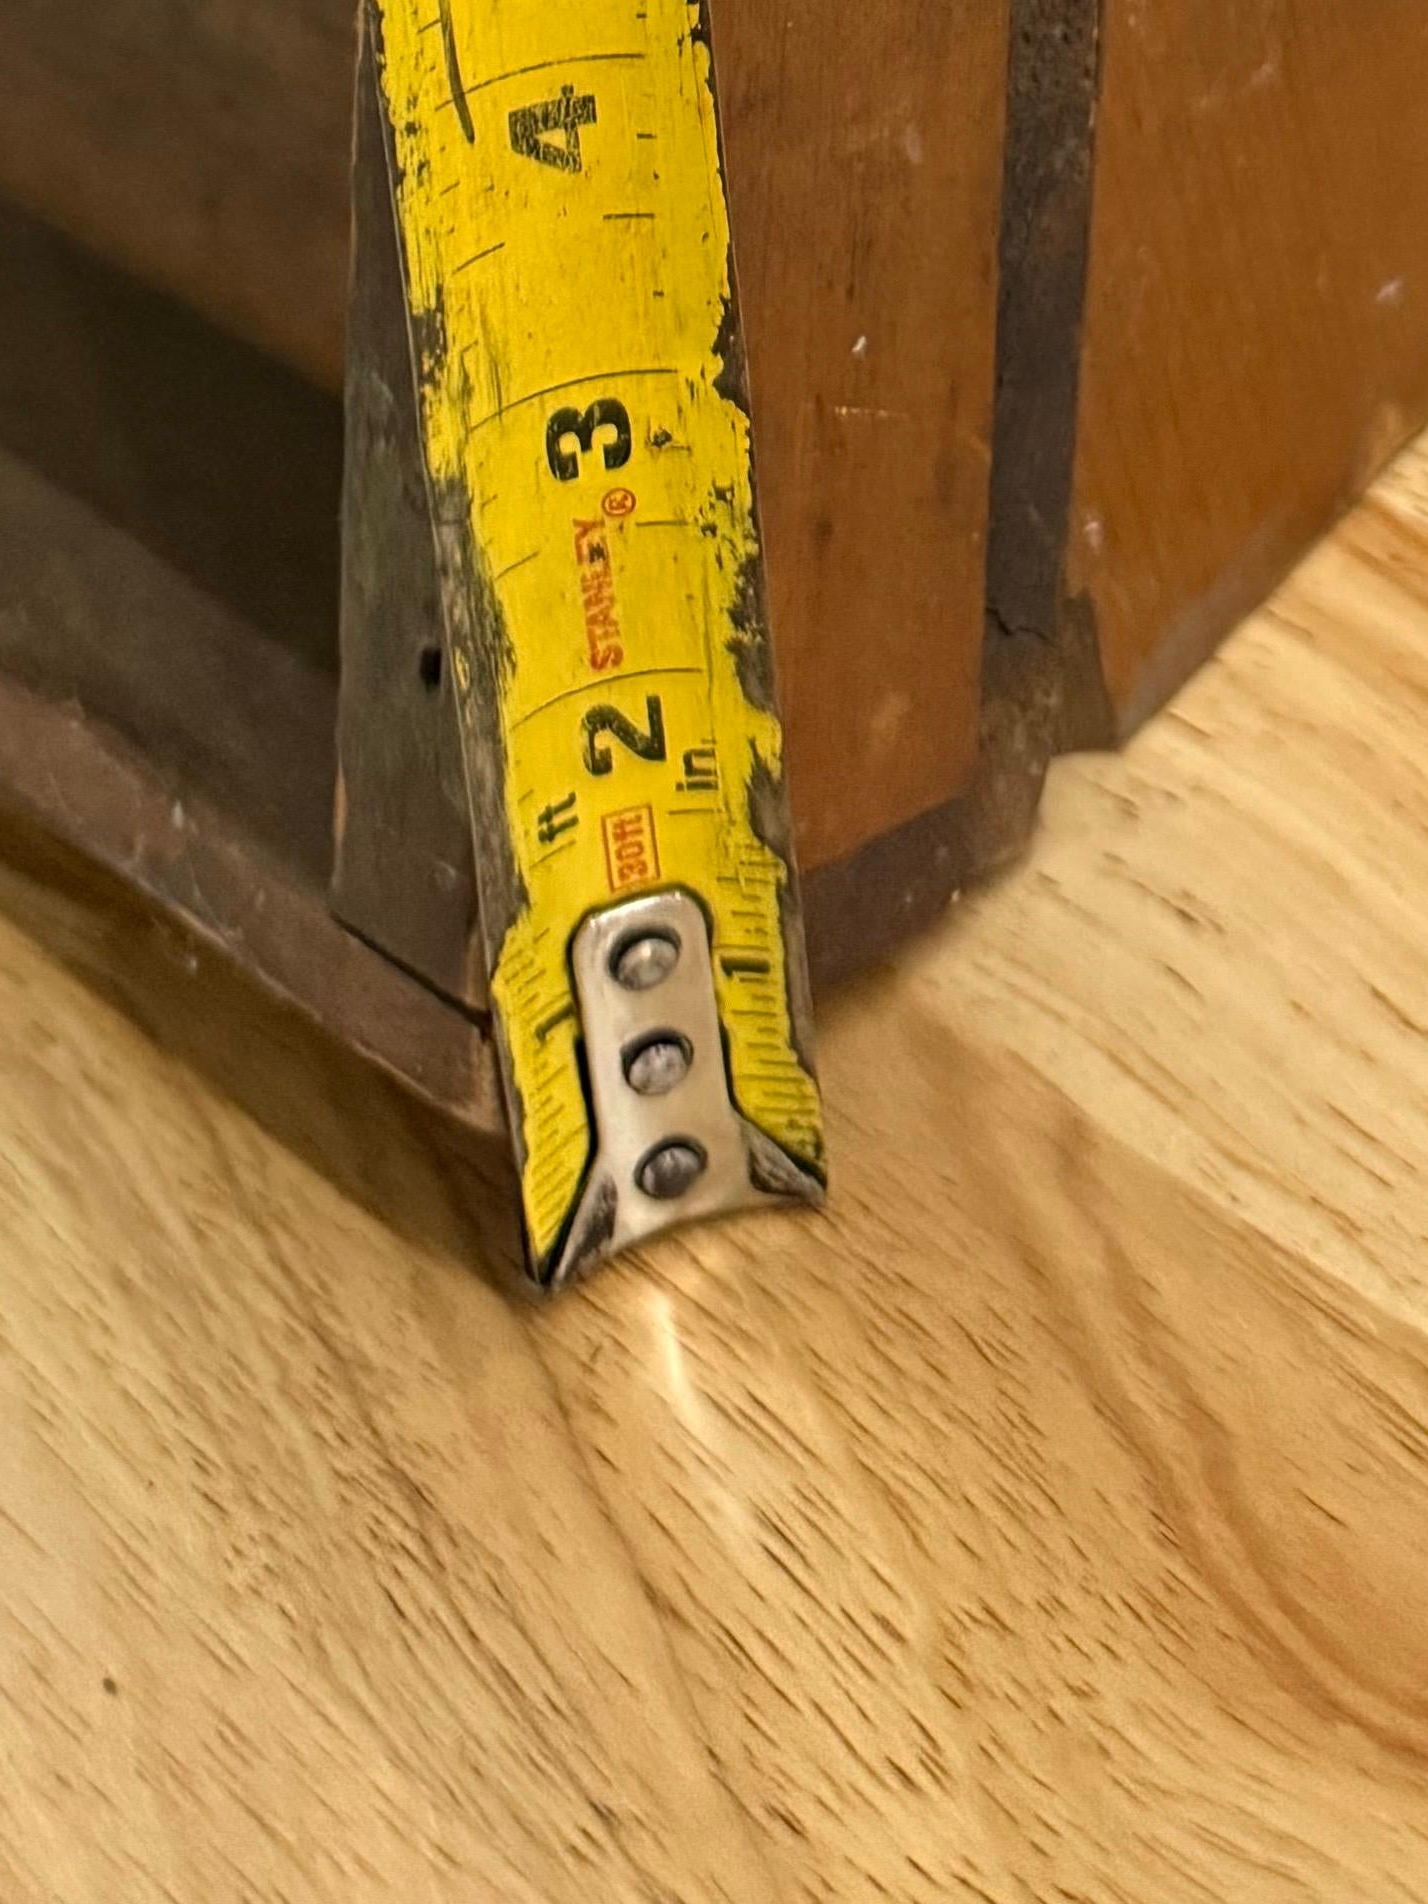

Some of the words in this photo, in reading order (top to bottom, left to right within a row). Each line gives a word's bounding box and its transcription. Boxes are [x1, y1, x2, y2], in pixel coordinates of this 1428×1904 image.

[507, 84, 598, 174] 4
[545, 397, 633, 482] 3
[580, 695, 668, 778] 2
[537, 791, 579, 845] ft
[719, 955, 771, 979] 1
